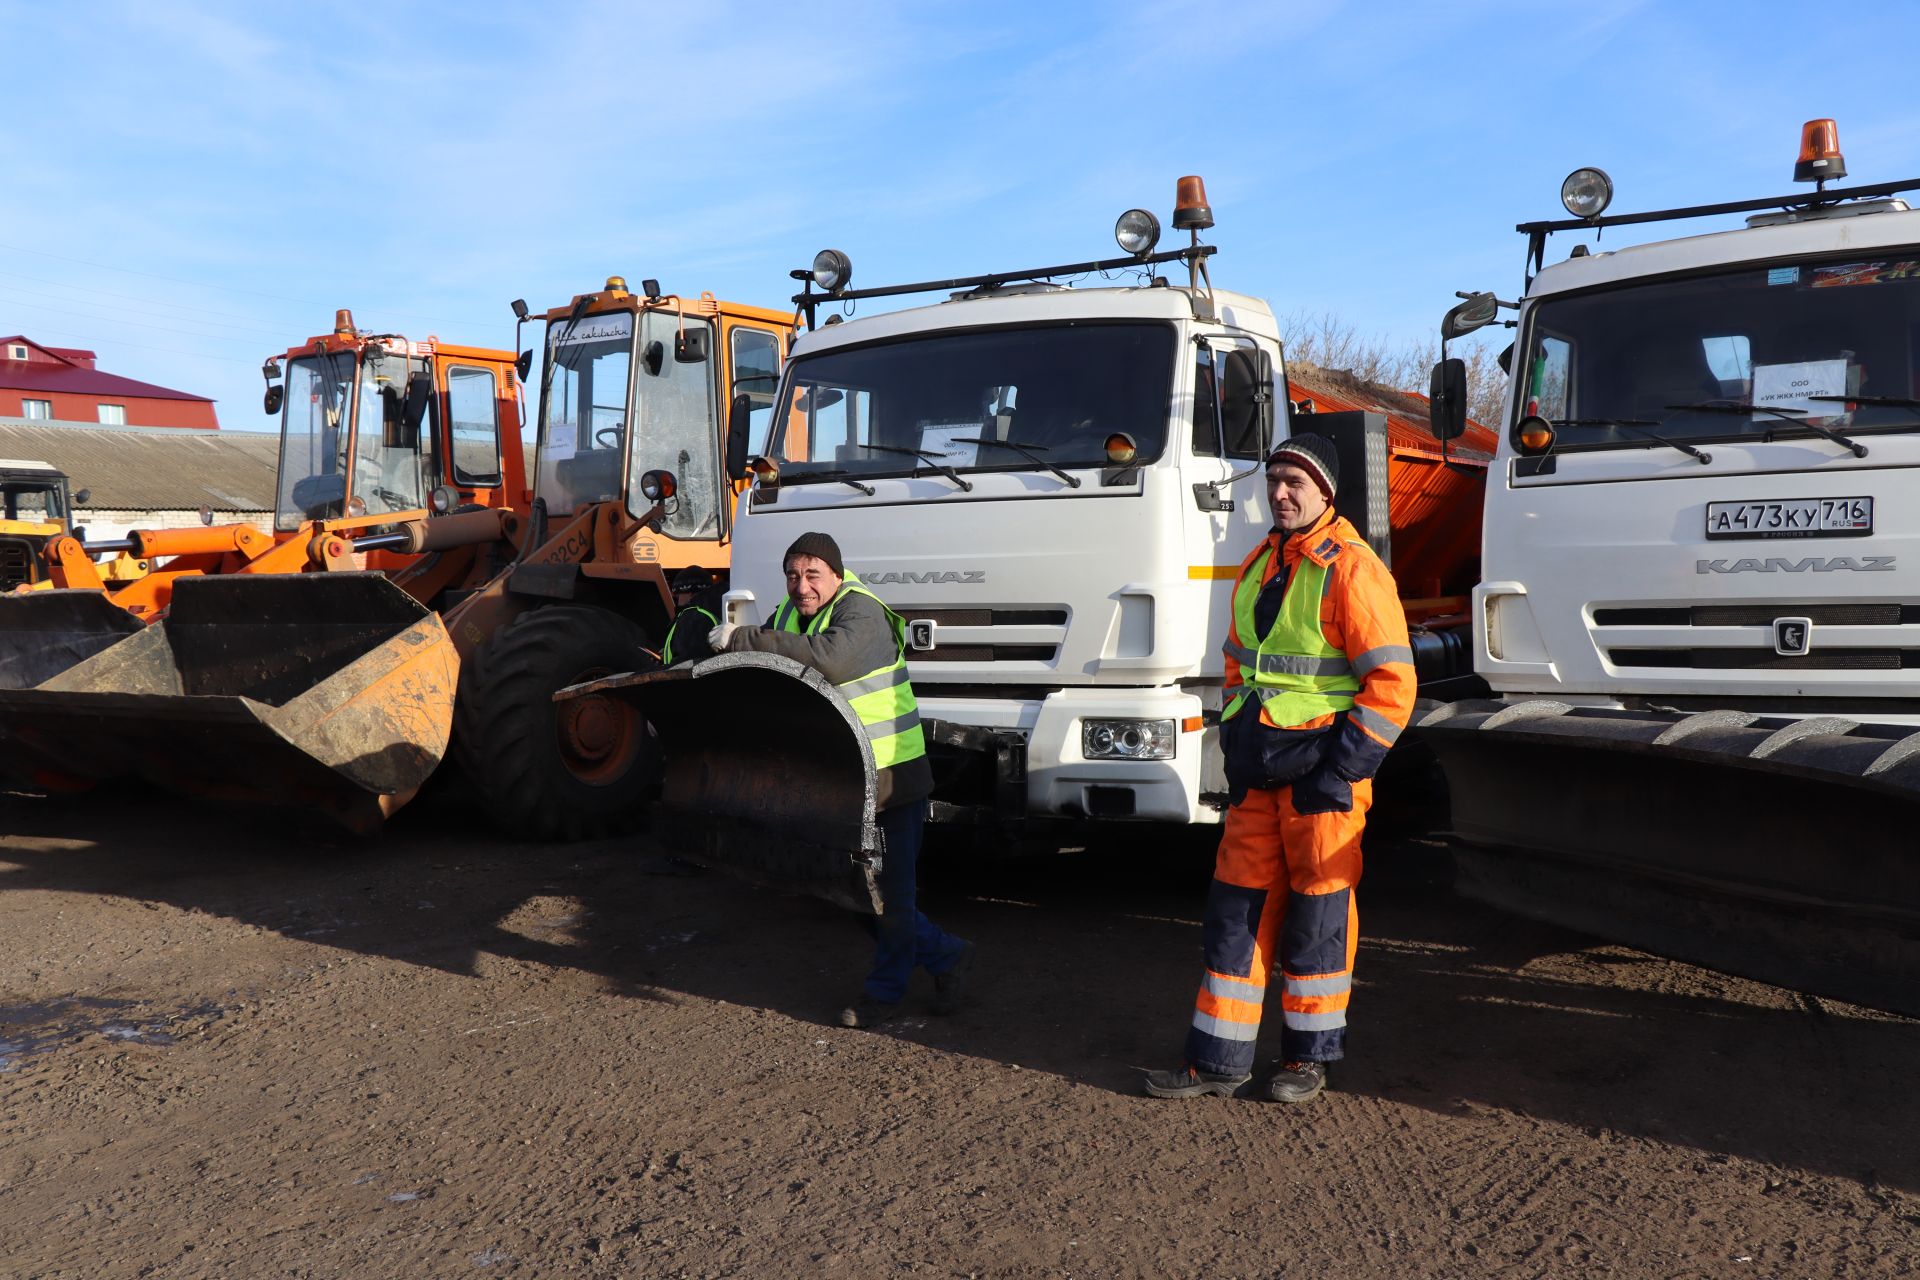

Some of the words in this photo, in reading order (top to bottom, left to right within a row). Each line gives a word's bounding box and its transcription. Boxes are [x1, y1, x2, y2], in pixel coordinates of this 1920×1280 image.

[1776, 392, 1794, 400] ЖКХ
[1795, 390, 1814, 398] НМР
[1717, 504, 1818, 530] А473КУ
[1823, 500, 1865, 521] 716
[1696, 556, 1897, 575] KAMAZ
[859, 570, 986, 585] KAMAZ
